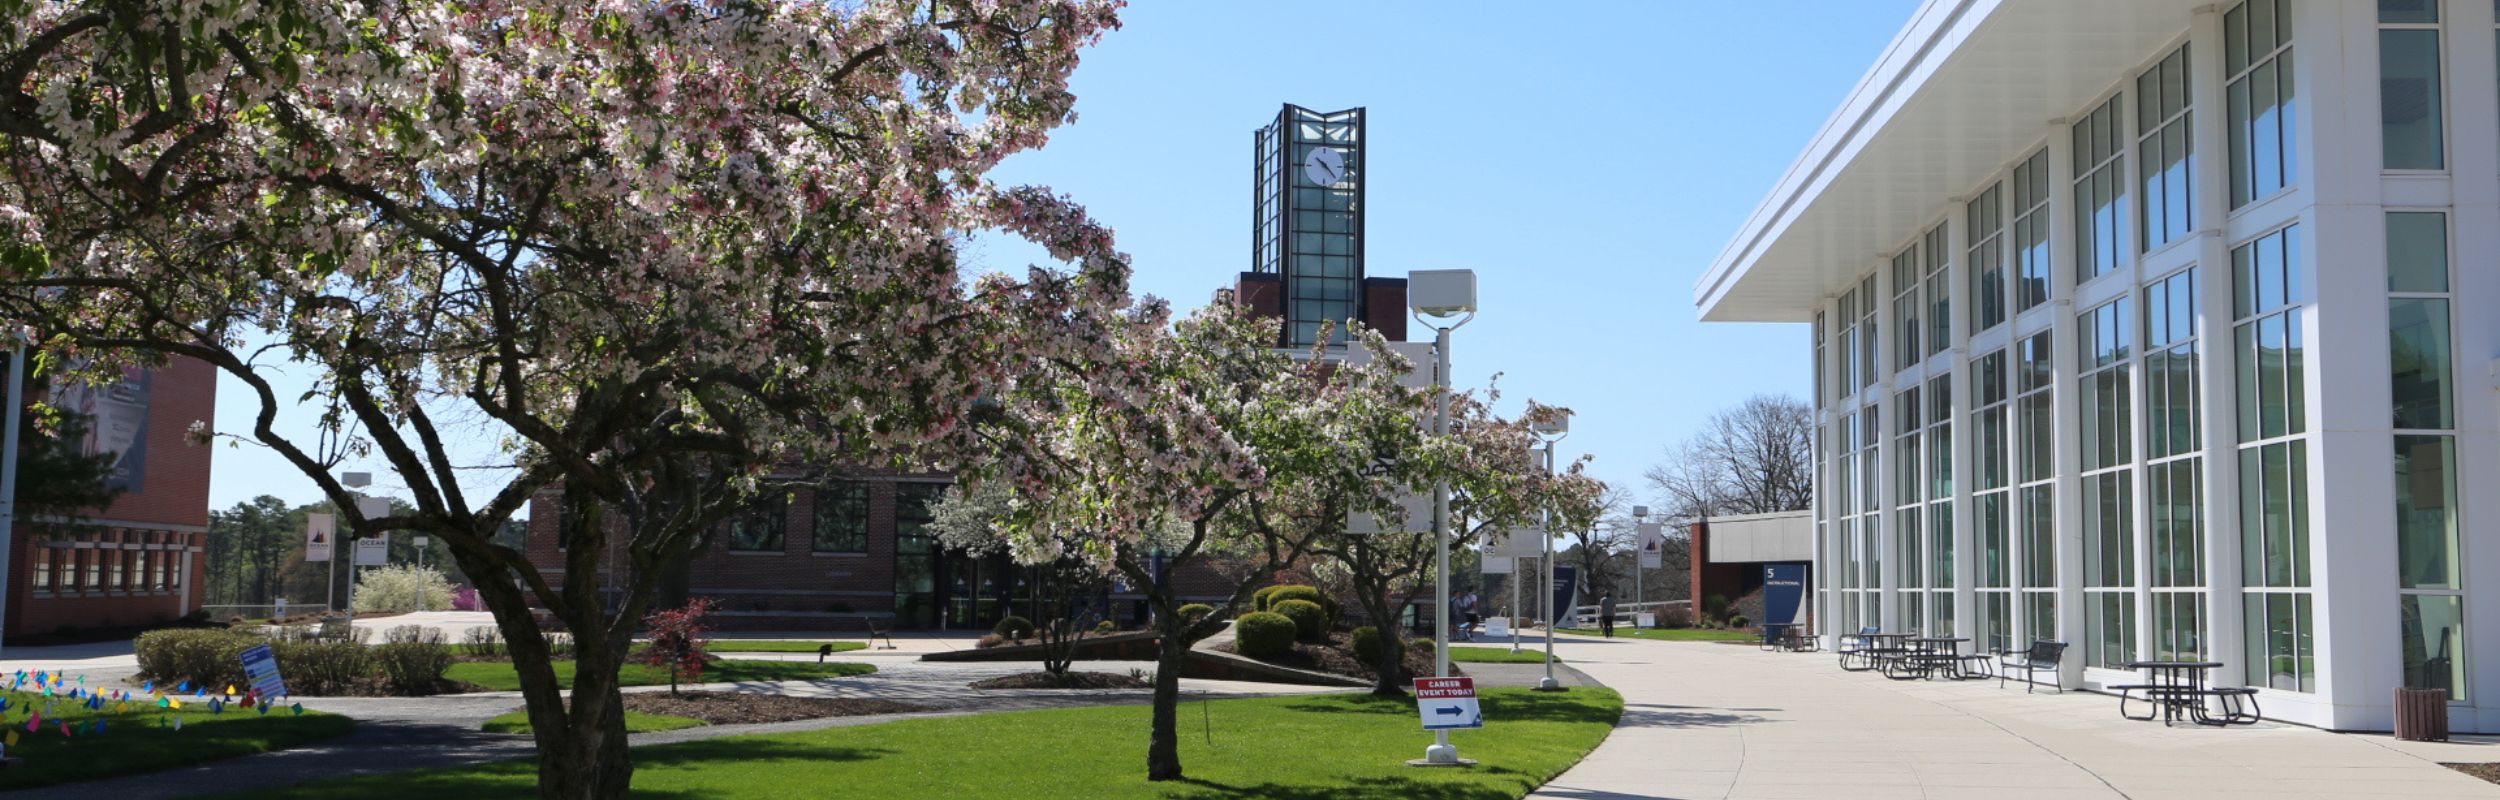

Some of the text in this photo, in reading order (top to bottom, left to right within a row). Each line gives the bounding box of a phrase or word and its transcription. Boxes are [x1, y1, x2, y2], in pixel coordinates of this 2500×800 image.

[1767, 568, 1775, 578] 5
[1428, 680, 1461, 688] CAREER
[1446, 688, 1473, 696] TODAY
